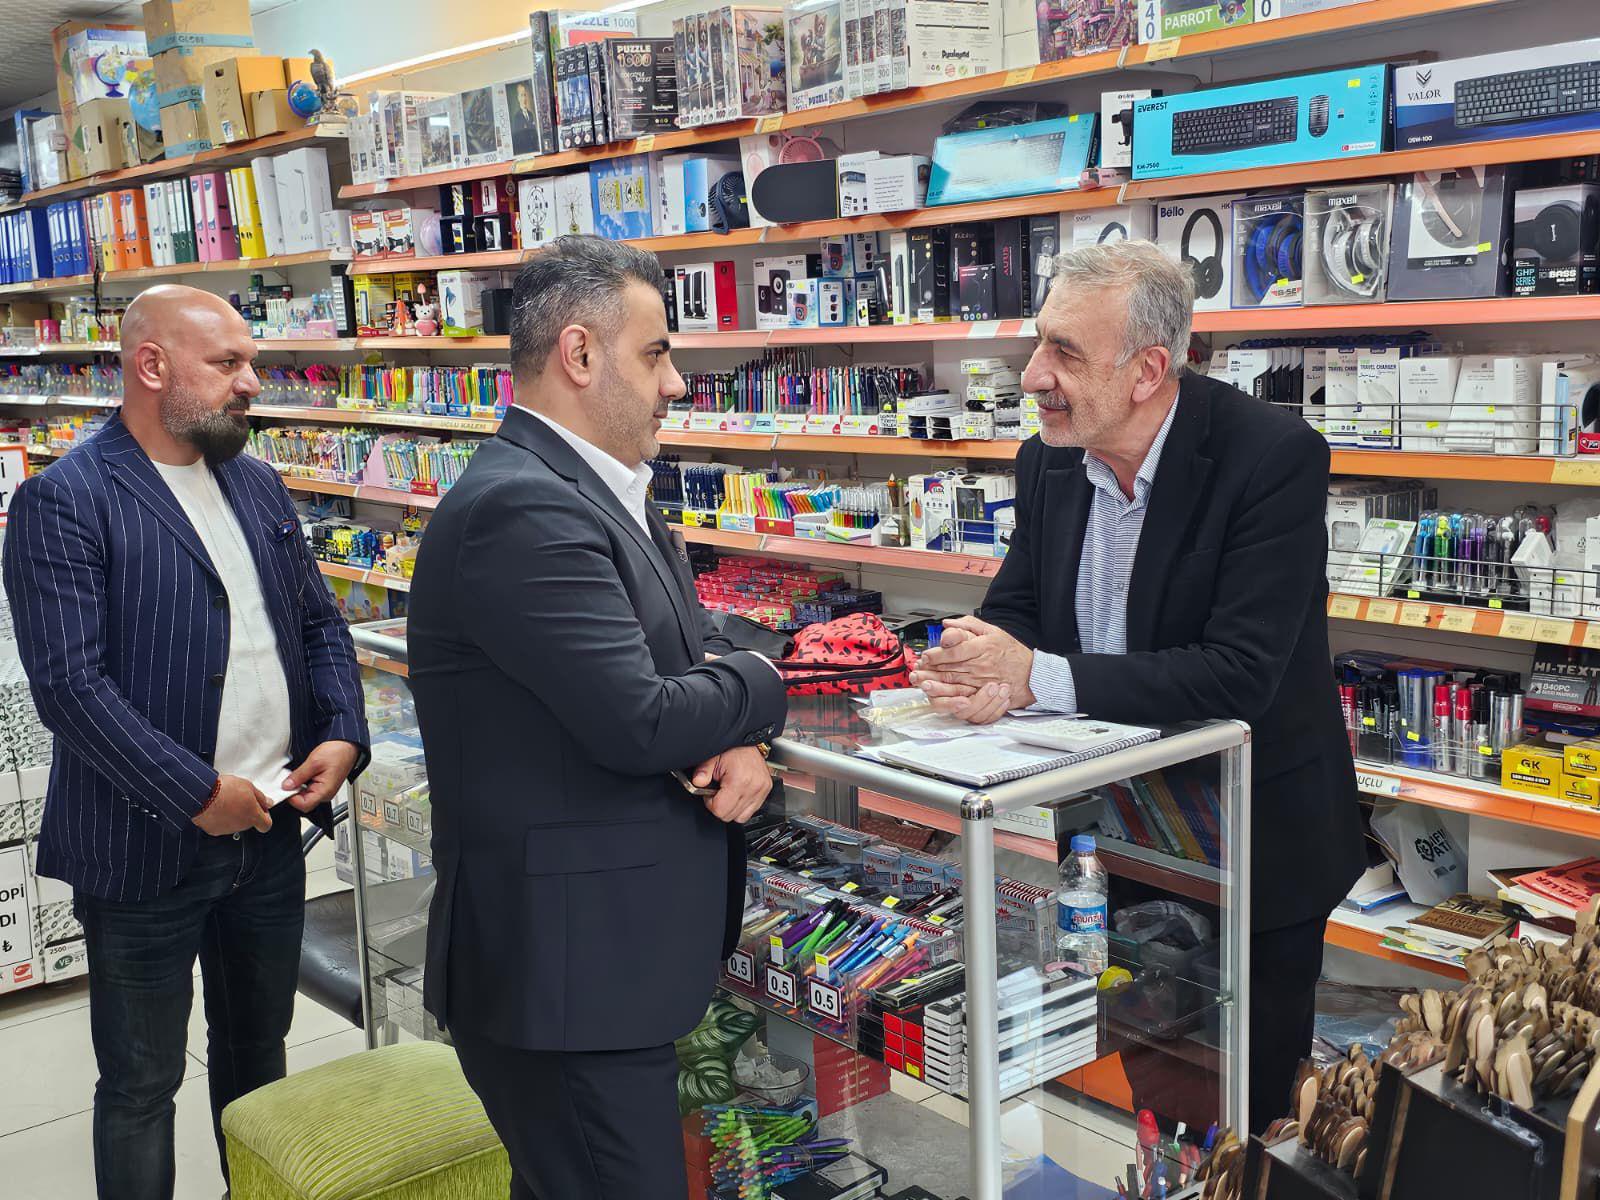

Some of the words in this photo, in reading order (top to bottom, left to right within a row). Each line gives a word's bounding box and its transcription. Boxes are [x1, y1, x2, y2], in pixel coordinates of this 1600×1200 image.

[614, 17, 635, 29] 1000
[1164, 8, 1213, 31] PARROT
[617, 45, 652, 54] PUZZLE
[616, 54, 652, 68] 1000
[808, 93, 829, 107] PUZZLE
[1137, 101, 1169, 113] EVEREST
[1254, 202, 1282, 213] maxell
[1328, 195, 1358, 207] maxell
[1516, 268, 1535, 277] GHP
[1515, 276, 1536, 286] SERIES
[1535, 661, 1600, 678] HI-TEXT
[1356, 775, 1383, 789] UÇLU
[362, 799, 374, 811] 0.7
[386, 807, 397, 821] 0.7
[409, 815, 420, 829] 0.7
[49, 945, 67, 955] 2500
[730, 957, 748, 977] 0.5
[771, 975, 789, 997] 0.5
[814, 989, 834, 1011] 0.5
